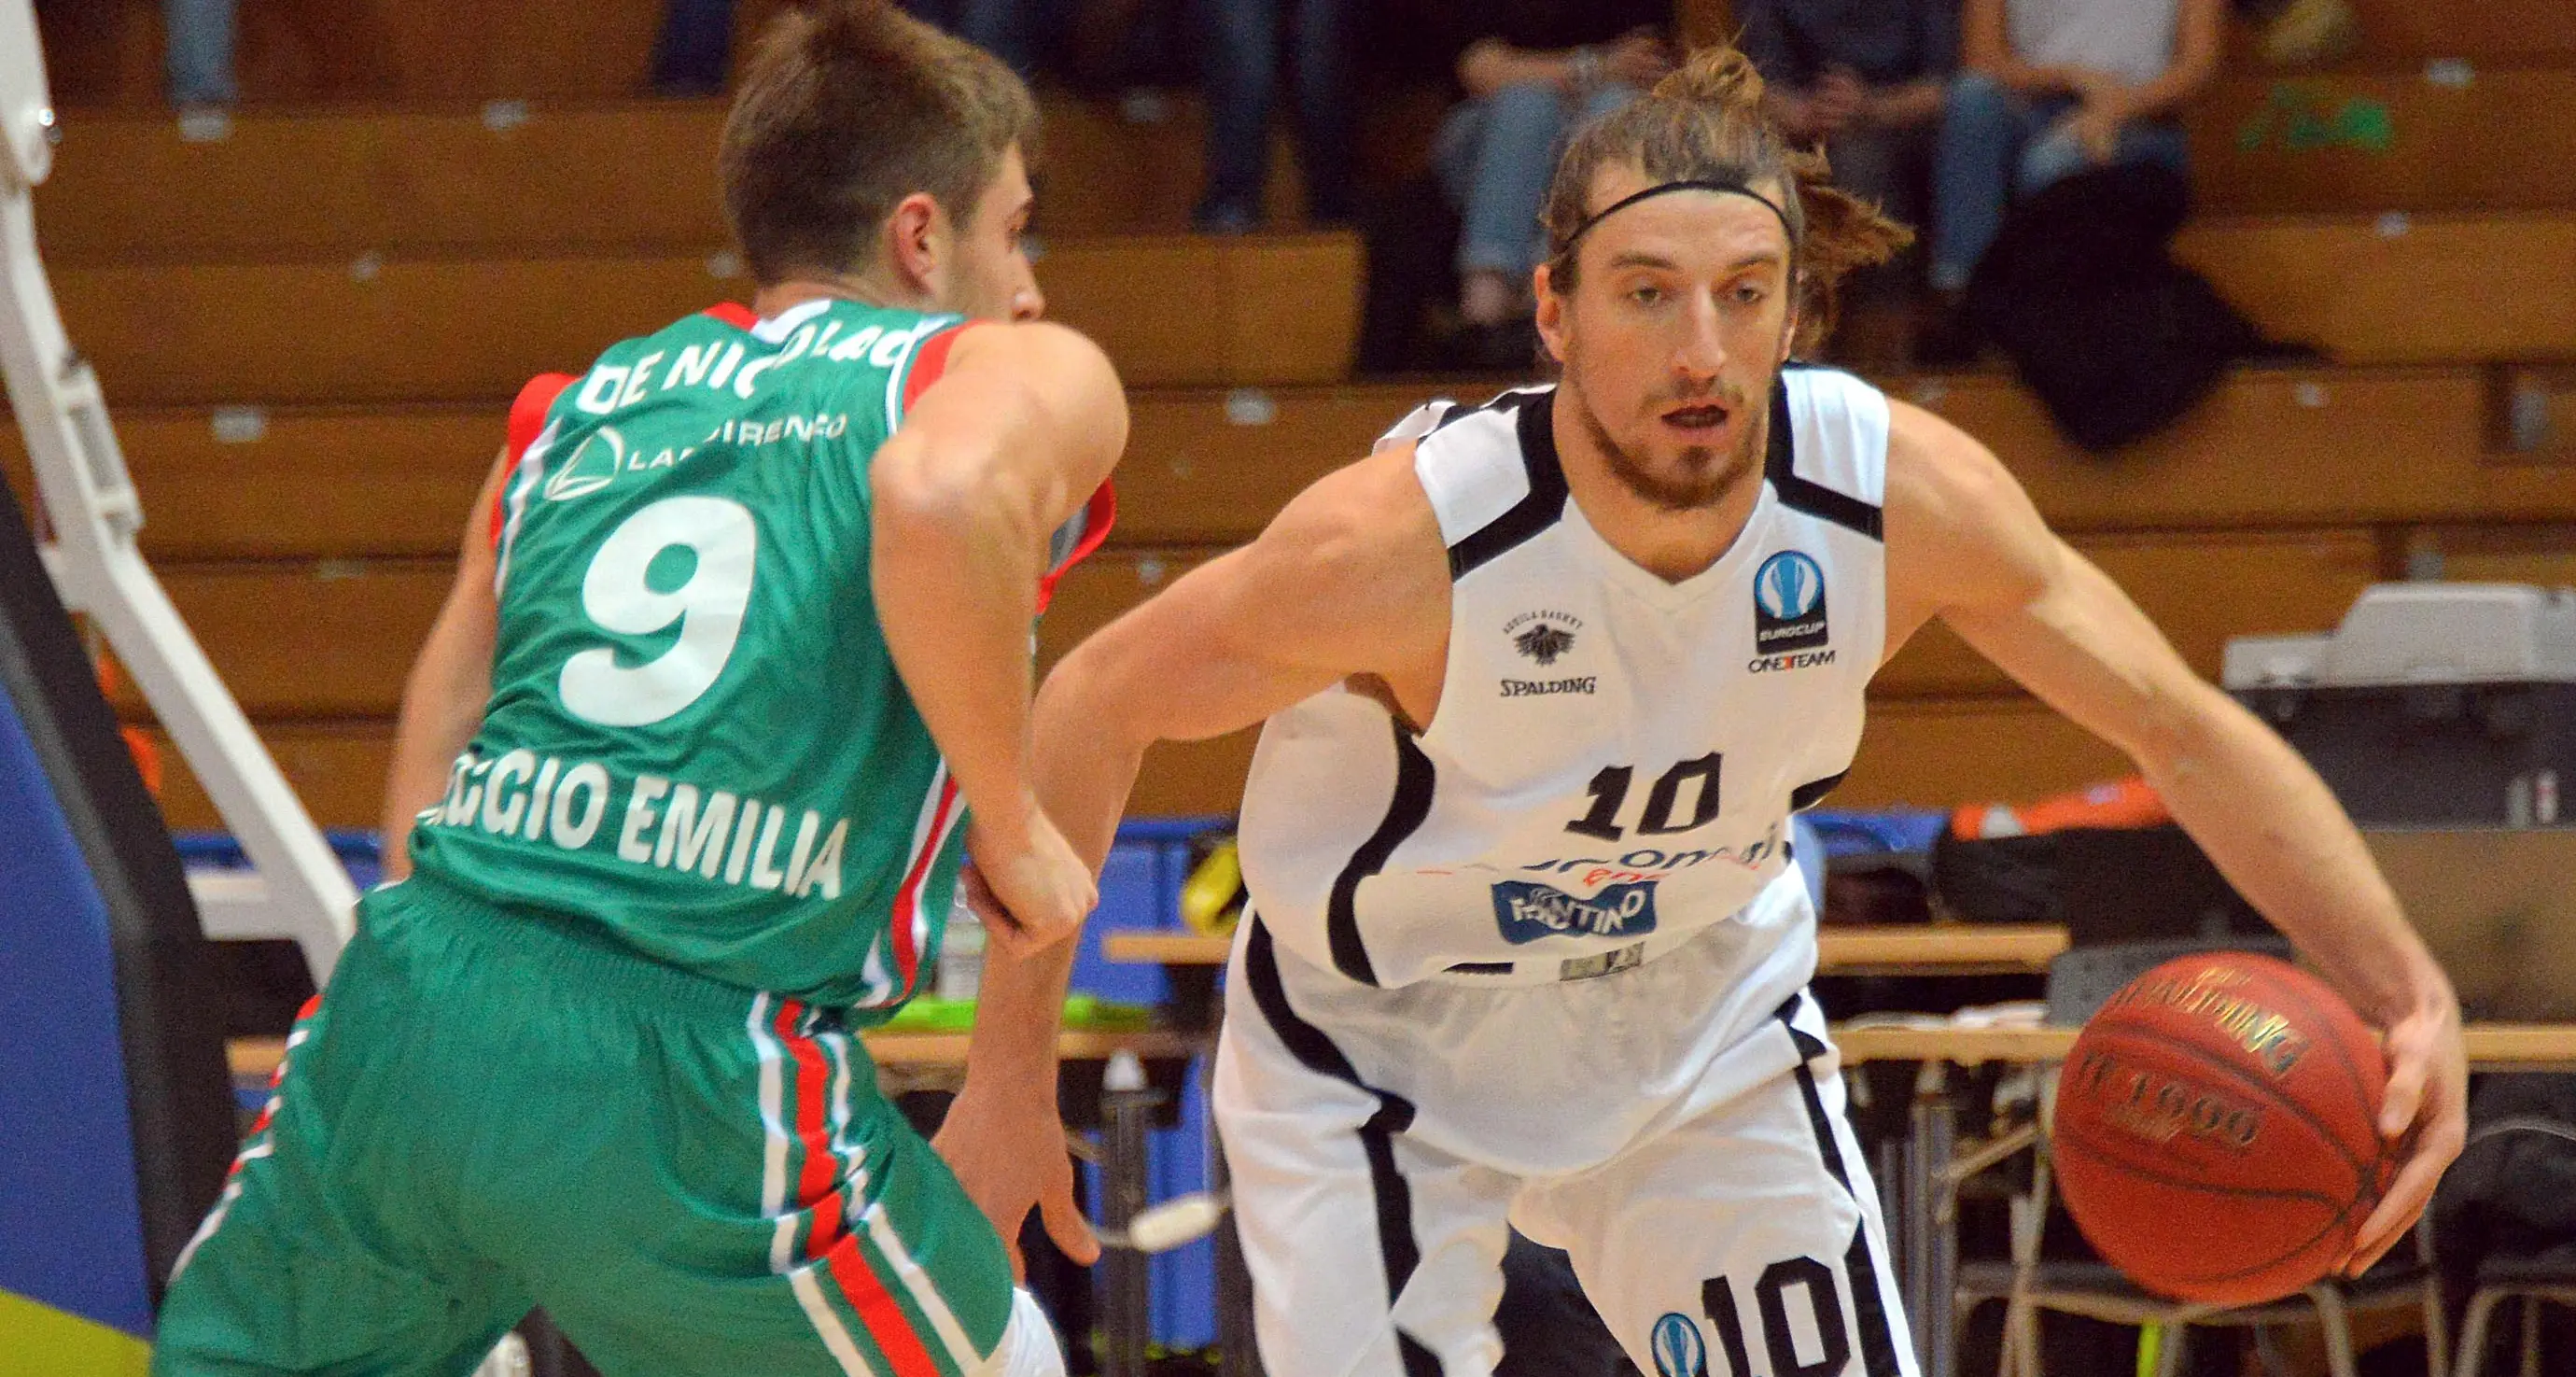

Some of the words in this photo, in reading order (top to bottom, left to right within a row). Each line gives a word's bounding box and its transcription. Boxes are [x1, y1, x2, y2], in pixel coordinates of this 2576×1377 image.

[576, 351, 665, 415] DE
[559, 496, 756, 727] 9
[1759, 620, 1826, 641] EUROCUP
[1500, 676, 1597, 697] SPALDING
[617, 774, 848, 899] EMILIA
[1564, 752, 1723, 842] 10
[1701, 1256, 1851, 1377] 10
